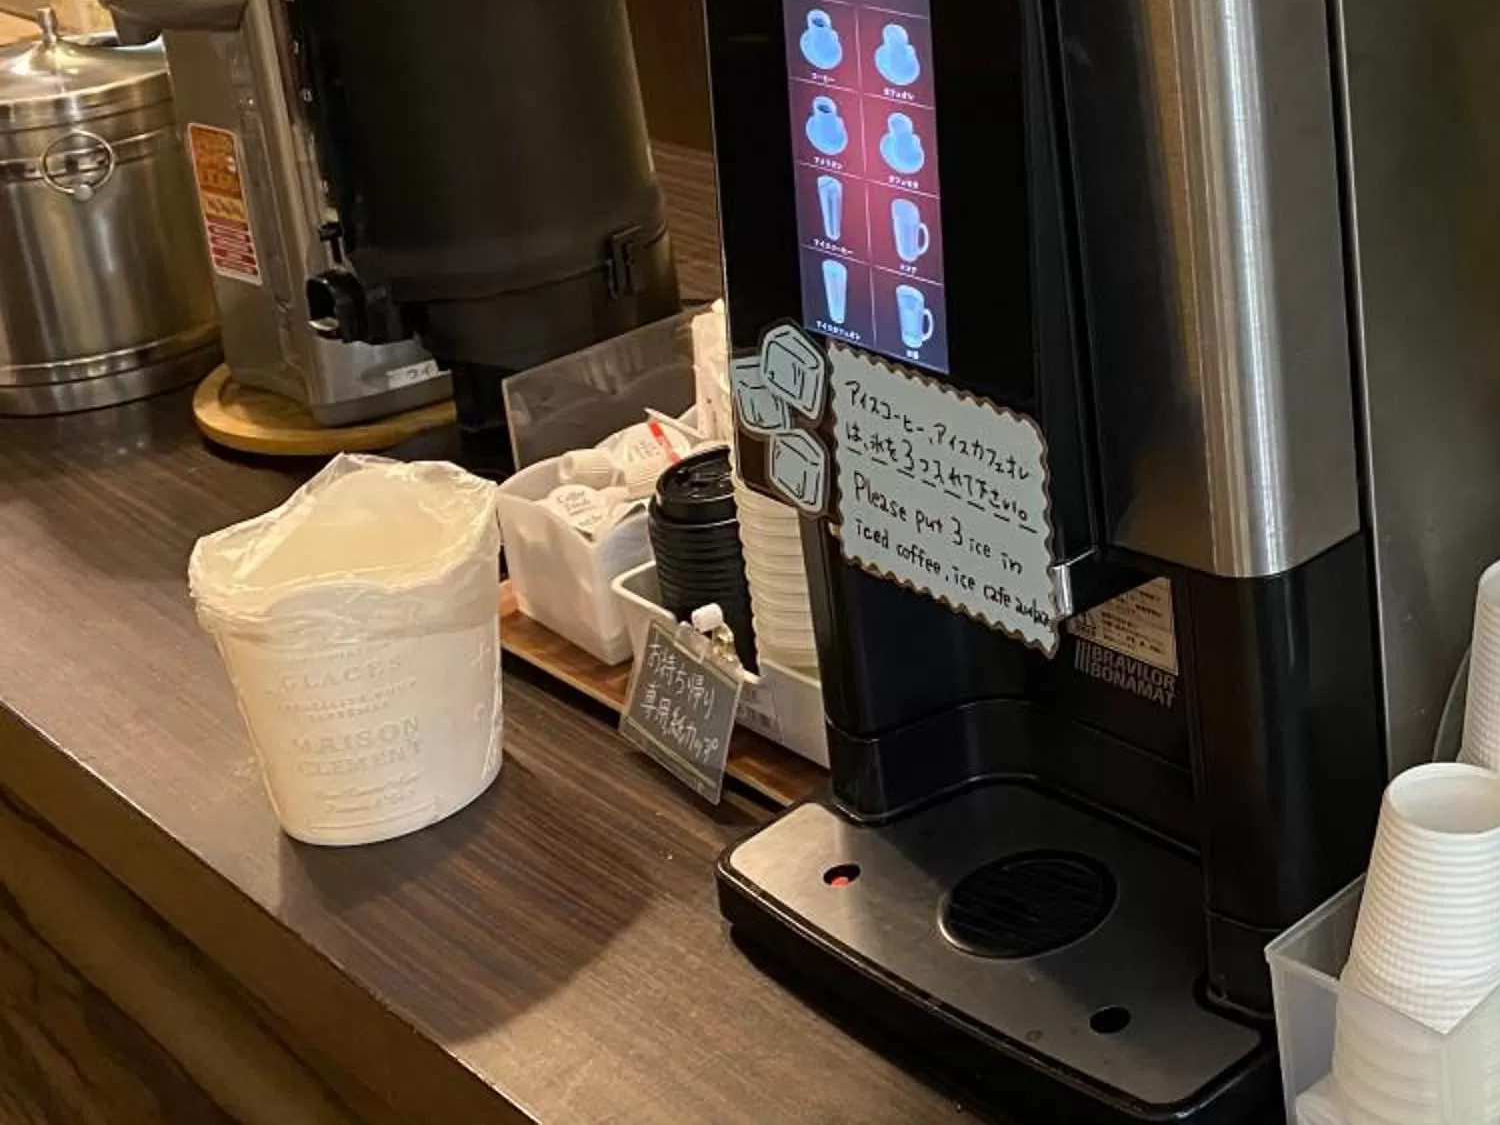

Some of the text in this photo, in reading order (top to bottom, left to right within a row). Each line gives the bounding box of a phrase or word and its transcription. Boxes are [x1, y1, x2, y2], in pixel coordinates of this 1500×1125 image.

[853, 470, 1022, 575] Please put 3 ice in
[855, 518, 889, 550] iced
